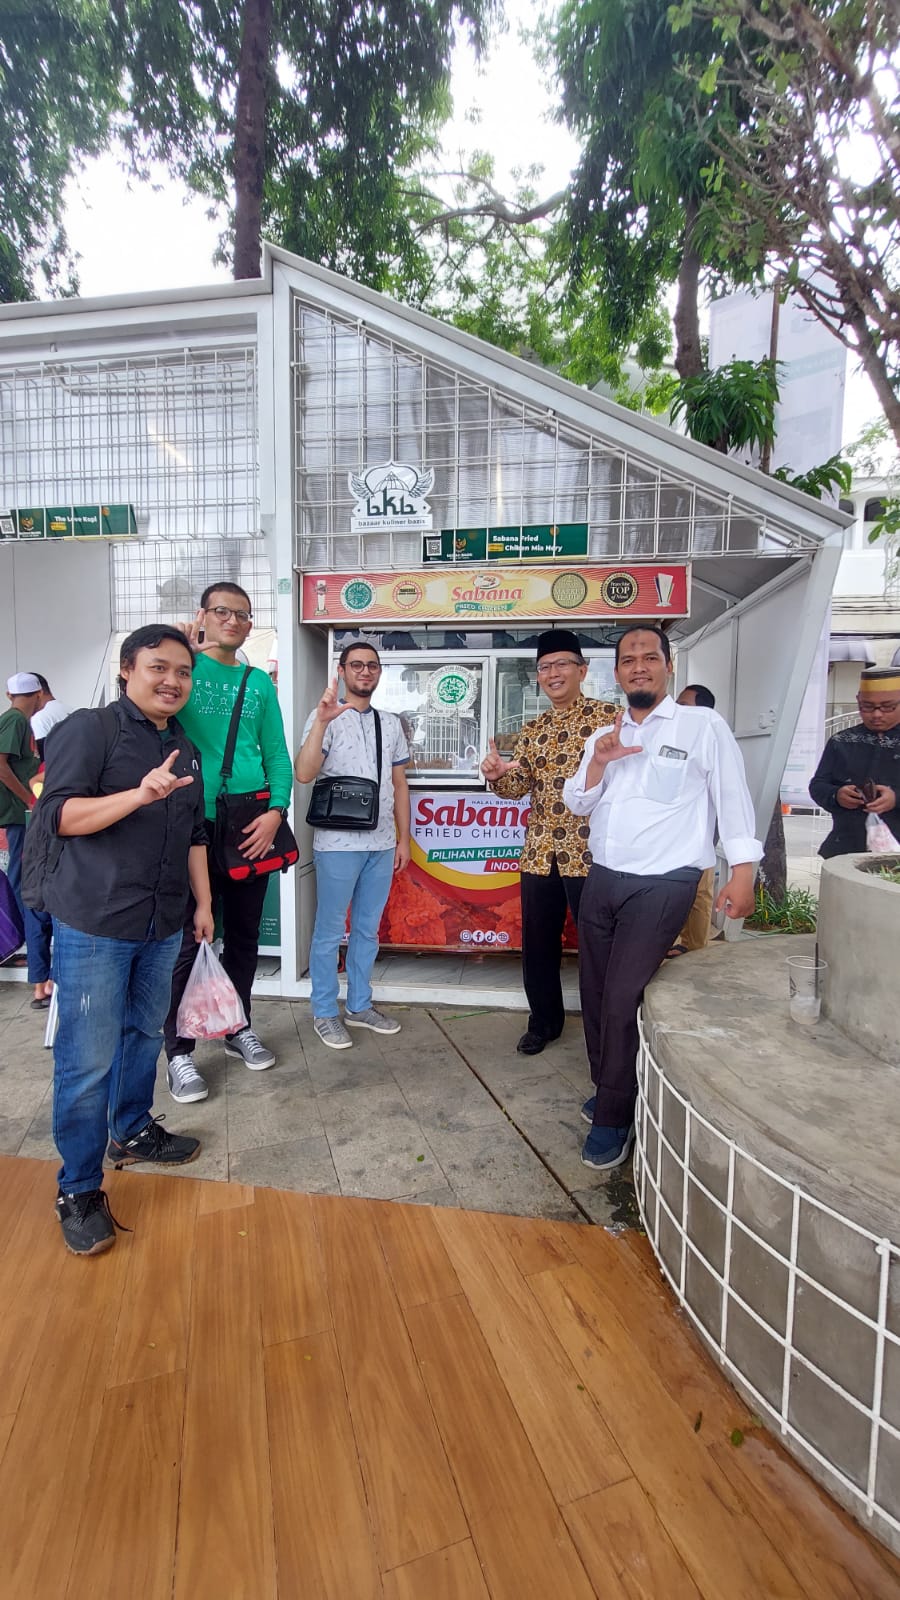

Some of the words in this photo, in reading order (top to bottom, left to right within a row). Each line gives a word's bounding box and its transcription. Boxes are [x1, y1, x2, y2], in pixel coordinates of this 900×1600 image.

[367, 486, 417, 516] bkb
[451, 586, 522, 601] Sabana
[415, 827, 462, 838] FRIED
[471, 828, 527, 839] CHICK
[432, 849, 476, 860] PILIHAN
[477, 848, 521, 858] KELUAR
[490, 861, 519, 871] INDO
